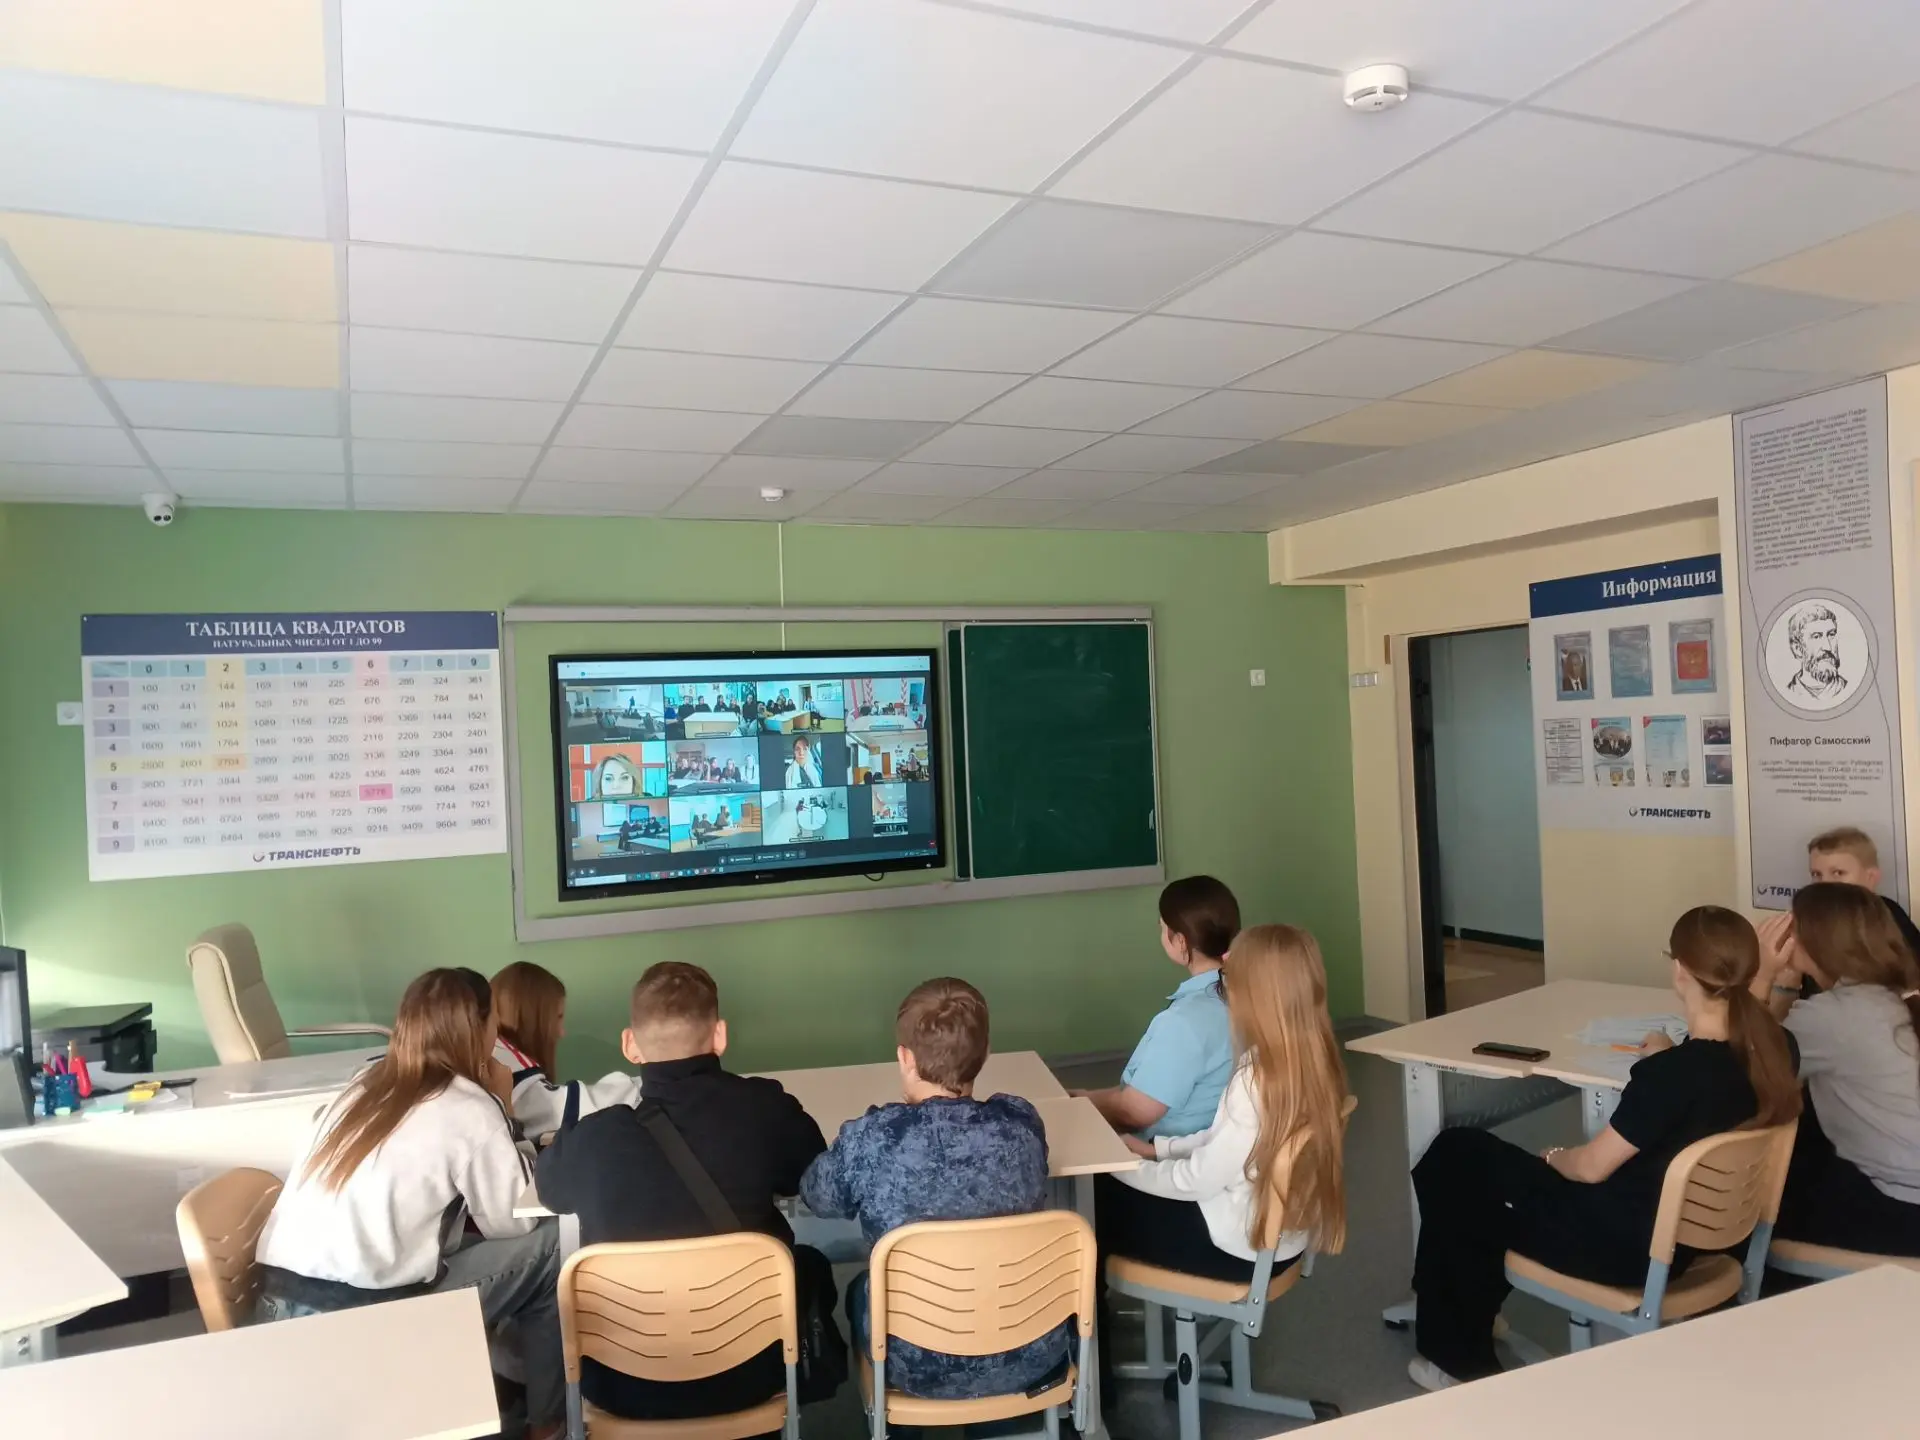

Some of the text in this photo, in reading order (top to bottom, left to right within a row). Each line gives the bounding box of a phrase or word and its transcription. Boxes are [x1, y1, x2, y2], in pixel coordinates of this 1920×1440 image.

[1602, 570, 1717, 598] Информация
[186, 620, 406, 638] ТАБЛИЦА КВАДРАТОВ
[213, 639, 292, 648] НАТУРАЛЬНЫХ
[294, 638, 330, 647] ЧИСЕЛ
[332, 638, 347, 646] ОТ
[355, 638, 370, 648] ДО
[372, 637, 382, 646] 99
[145, 657, 477, 674] 0 1 2 3 4 5 6 7 8 9
[109, 684, 114, 694] 1
[108, 704, 115, 713] 2
[110, 723, 116, 732] 3
[1770, 736, 1871, 747] Пифагор Самосский
[109, 743, 116, 751] 4
[110, 762, 117, 772] 5
[110, 781, 118, 791] 6
[112, 801, 118, 810] 7
[1640, 808, 1711, 819] ТРАНСНЕФТЬ
[112, 820, 119, 830] 8
[113, 840, 120, 849] 9
[269, 847, 360, 860] ТРАНСНЕФТЬ
